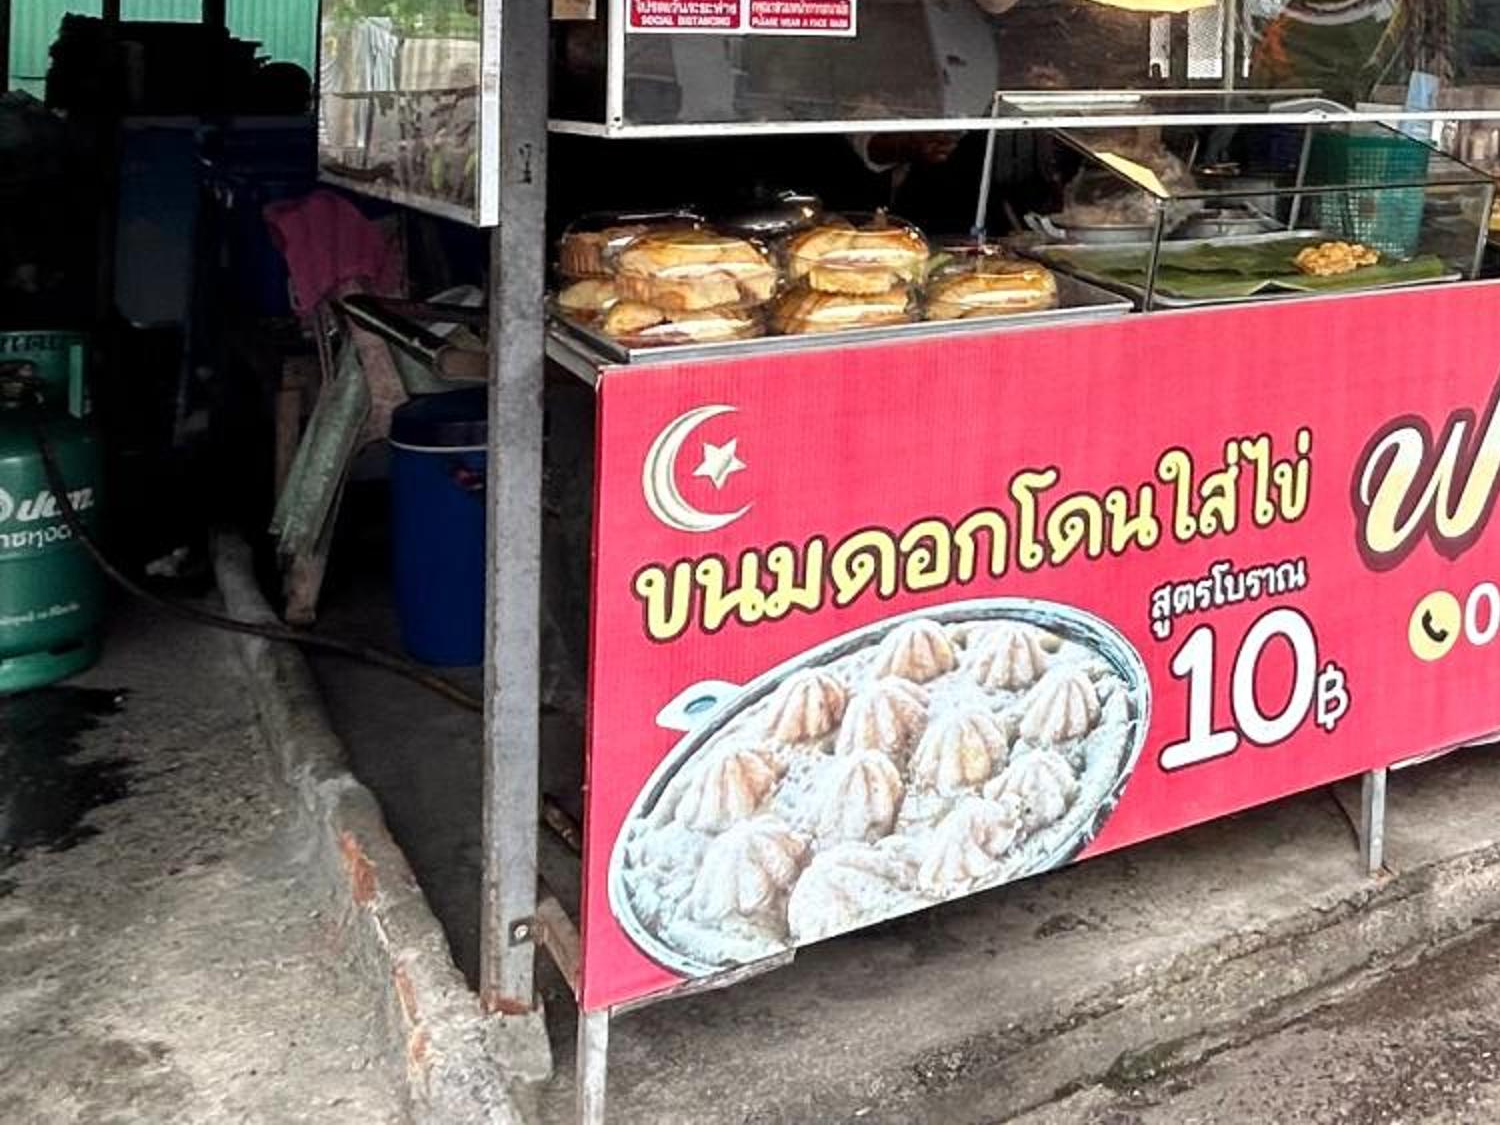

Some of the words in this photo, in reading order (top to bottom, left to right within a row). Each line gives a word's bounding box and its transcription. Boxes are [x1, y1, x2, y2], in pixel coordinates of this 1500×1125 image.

[635, 431, 1312, 640] ขนมดอกโดนใส่ไข่
[1151, 558, 1307, 635] สูตรโบราณ
